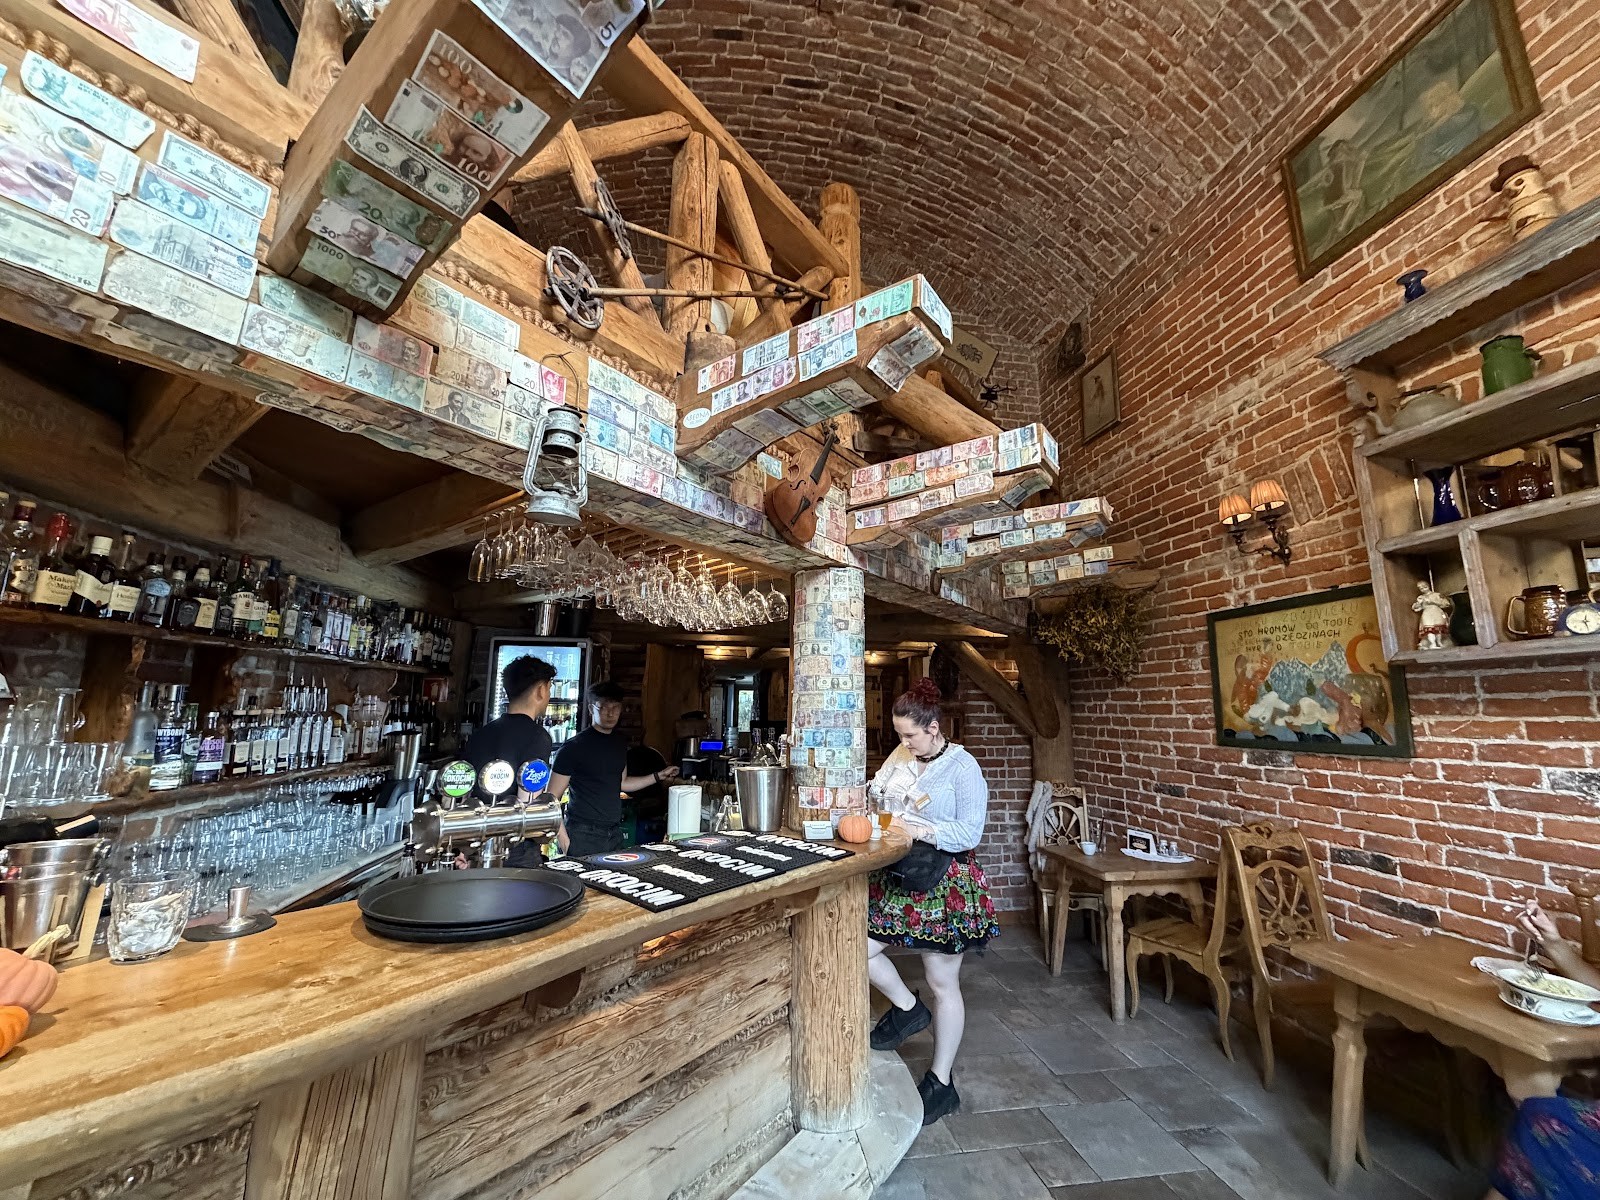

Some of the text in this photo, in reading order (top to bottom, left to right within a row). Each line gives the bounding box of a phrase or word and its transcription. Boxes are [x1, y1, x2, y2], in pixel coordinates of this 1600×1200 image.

[600, 21, 618, 40] 5
[439, 43, 472, 74] 100
[457, 157, 491, 183] 100
[69, 208, 92, 229] 20
[359, 201, 383, 220] 20
[316, 242, 344, 260] 1000
[325, 370, 343, 380] 200
[524, 378, 536, 389] 20
[1238, 629, 1253, 640] STO
[677, 849, 776, 878] OKOCIM
[578, 869, 686, 906] OKOCIM
